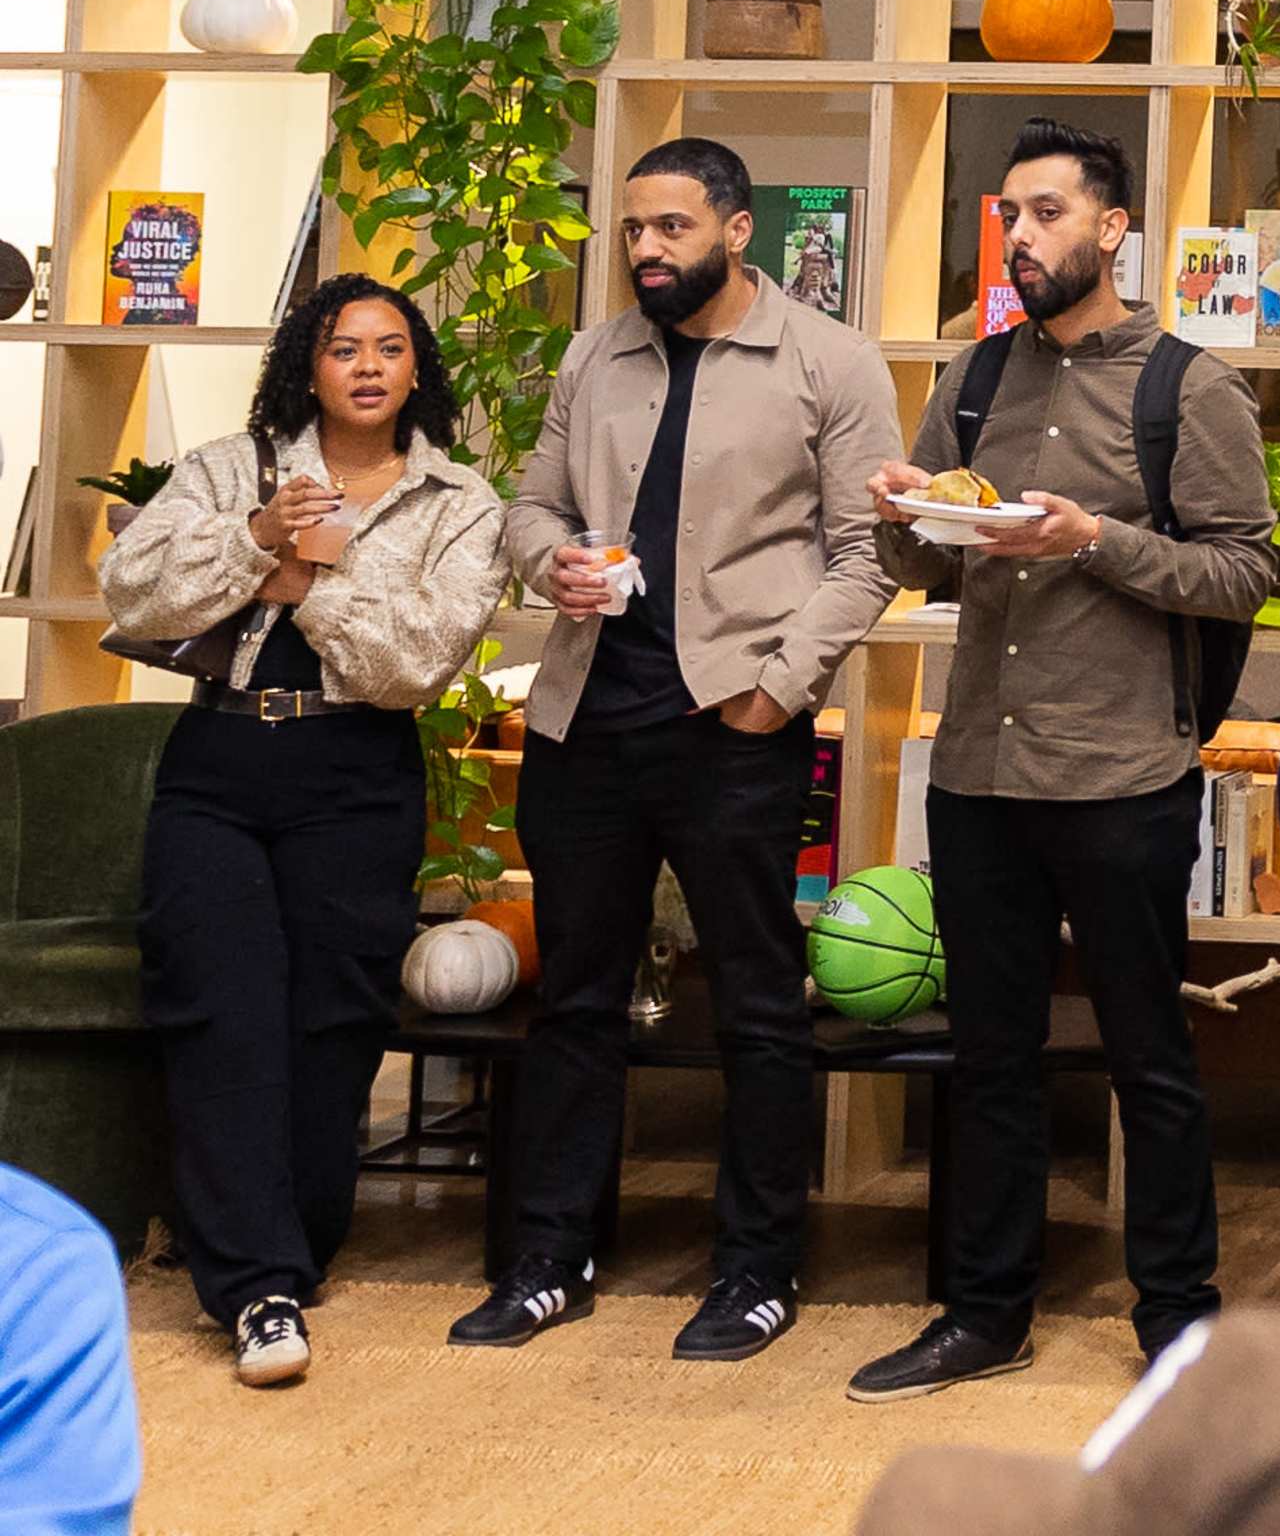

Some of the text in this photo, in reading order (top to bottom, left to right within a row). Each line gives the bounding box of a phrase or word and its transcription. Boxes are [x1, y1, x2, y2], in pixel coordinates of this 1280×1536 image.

[788, 187, 848, 199] PROSPECT
[801, 200, 833, 210] PARK
[131, 221, 181, 239] VIRAL
[118, 241, 192, 260] JUSTICE
[1188, 253, 1247, 275] COLOR
[119, 296, 186, 310] BENJAMIN
[1198, 294, 1233, 315] LAW
